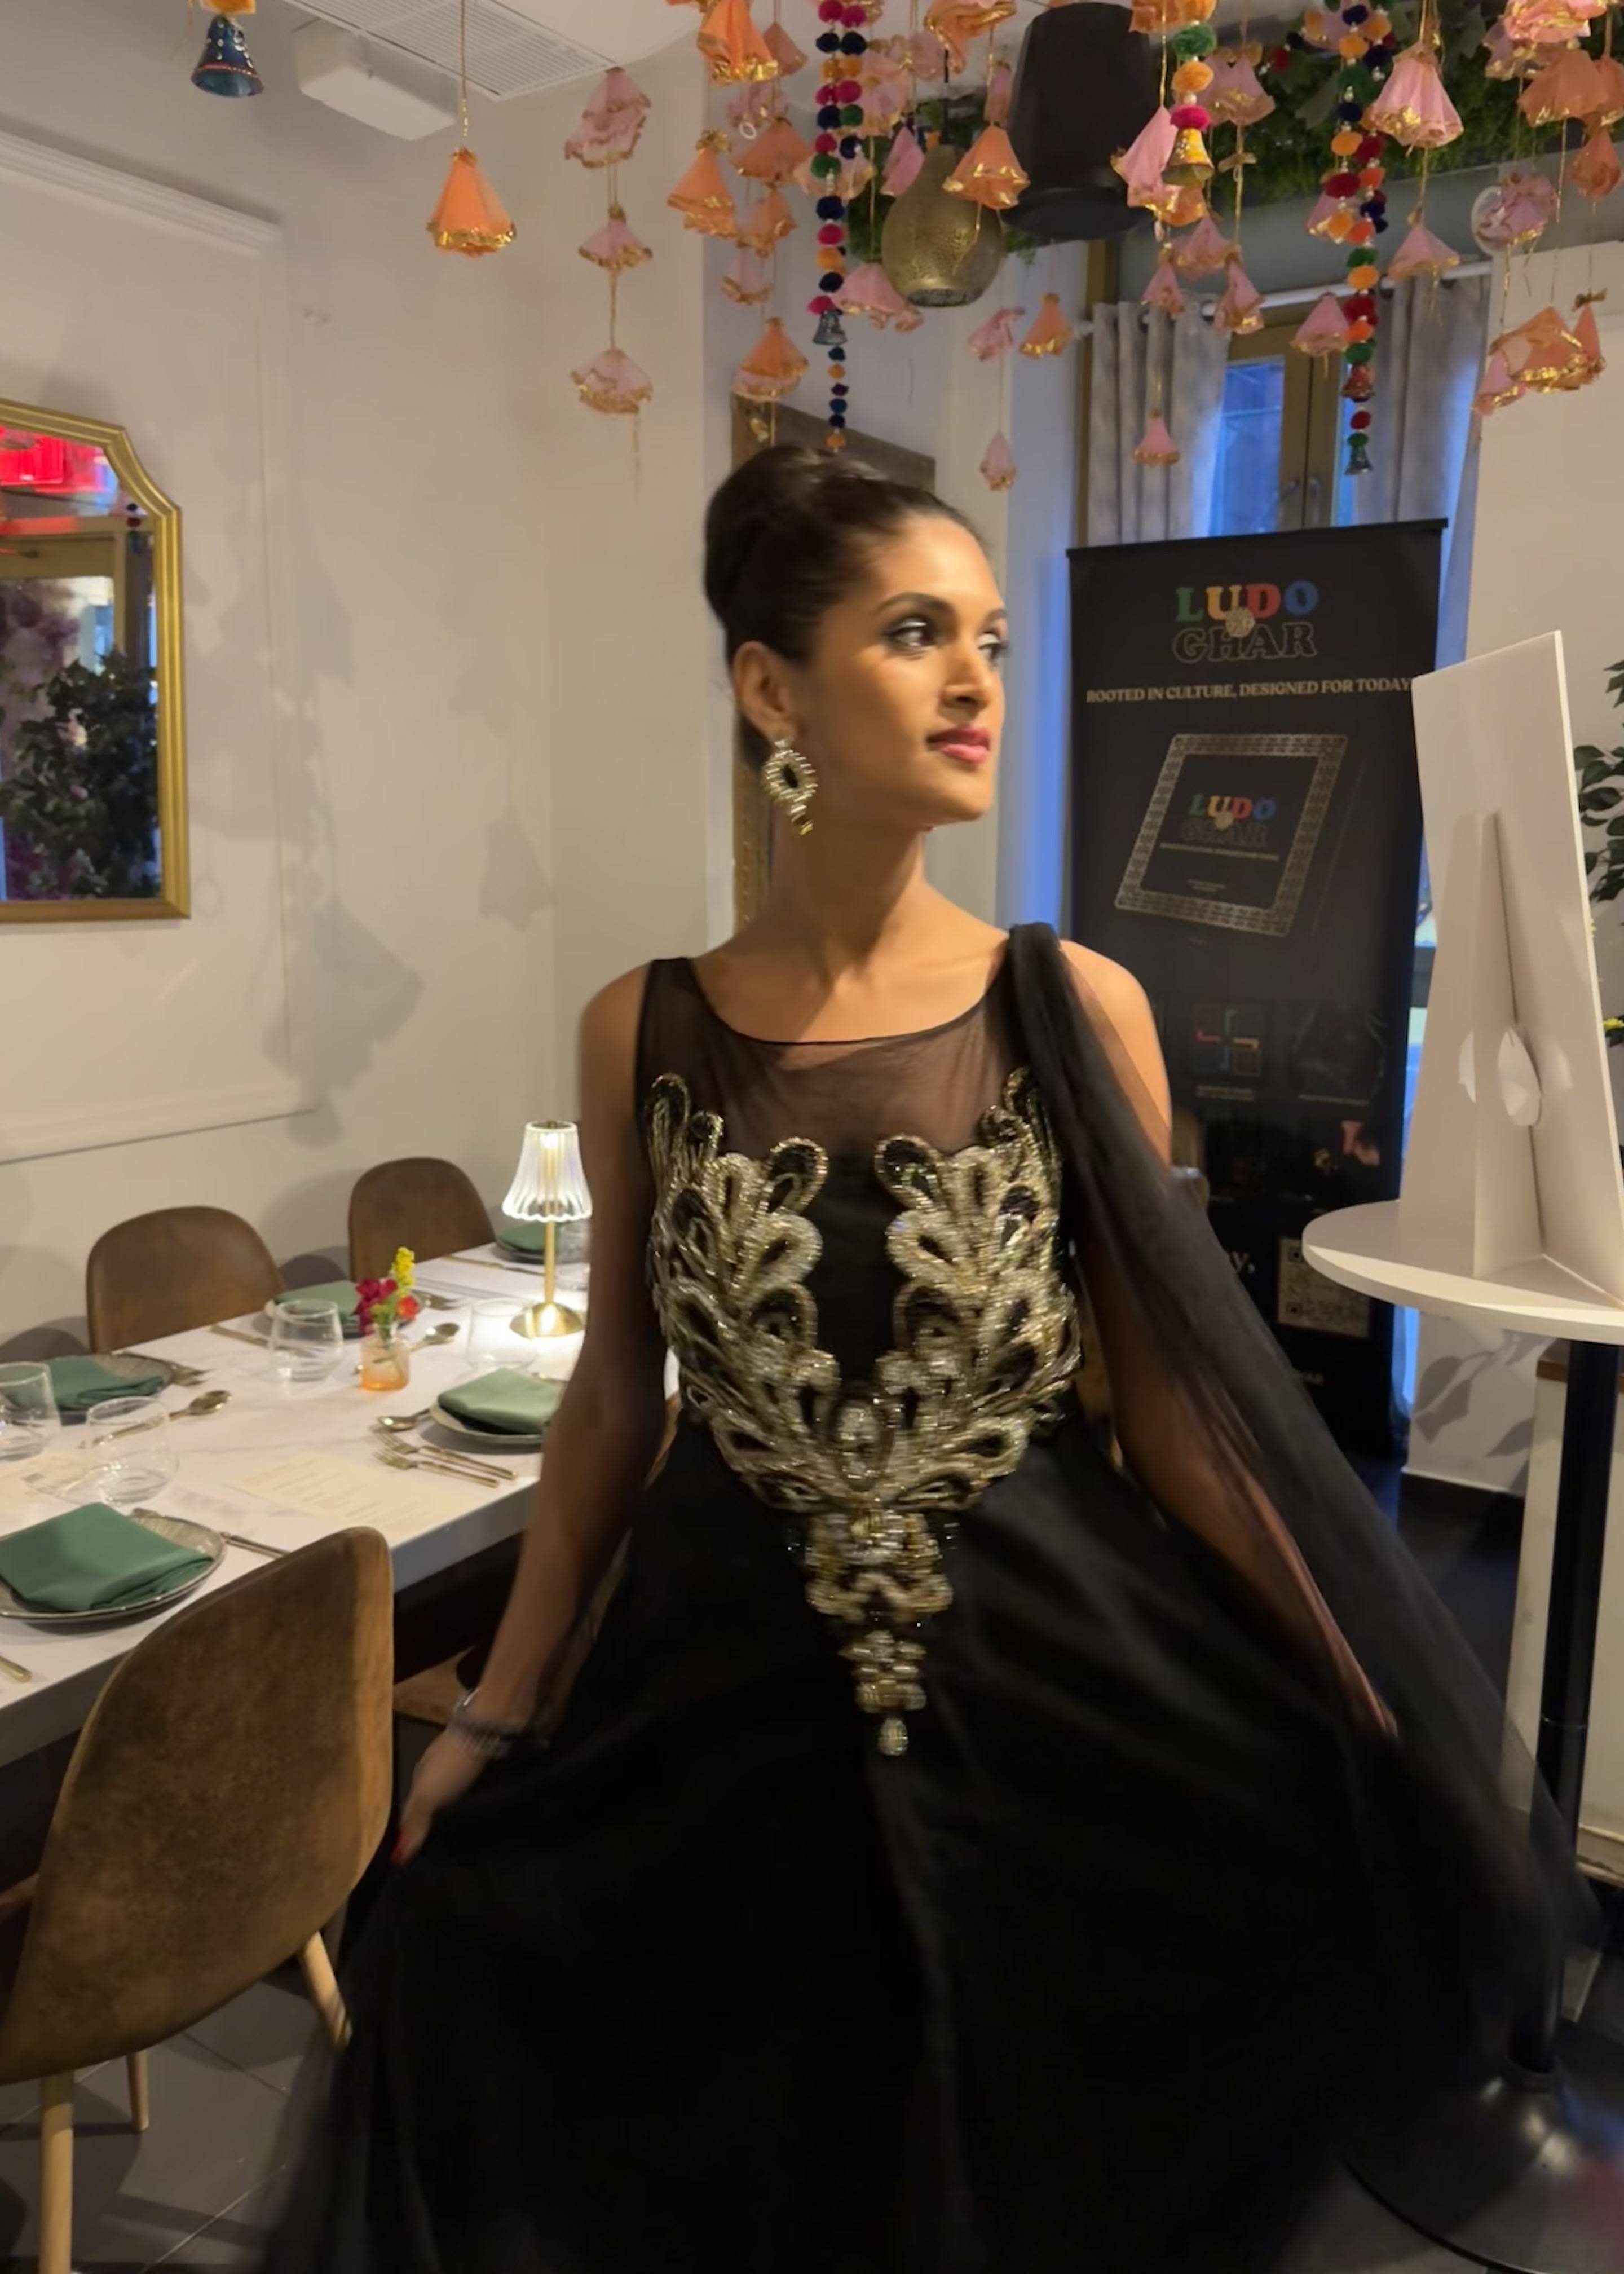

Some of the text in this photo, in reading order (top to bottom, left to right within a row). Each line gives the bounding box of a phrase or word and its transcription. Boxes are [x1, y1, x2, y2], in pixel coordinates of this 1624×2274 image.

[1175, 580, 1318, 622] LUDO
[1172, 622, 1318, 663] GHAR
[1086, 677, 1411, 703] ROOTED IN CULTURE, DESIGNED FOR TODAY
[1189, 794, 1277, 819] LUDO
